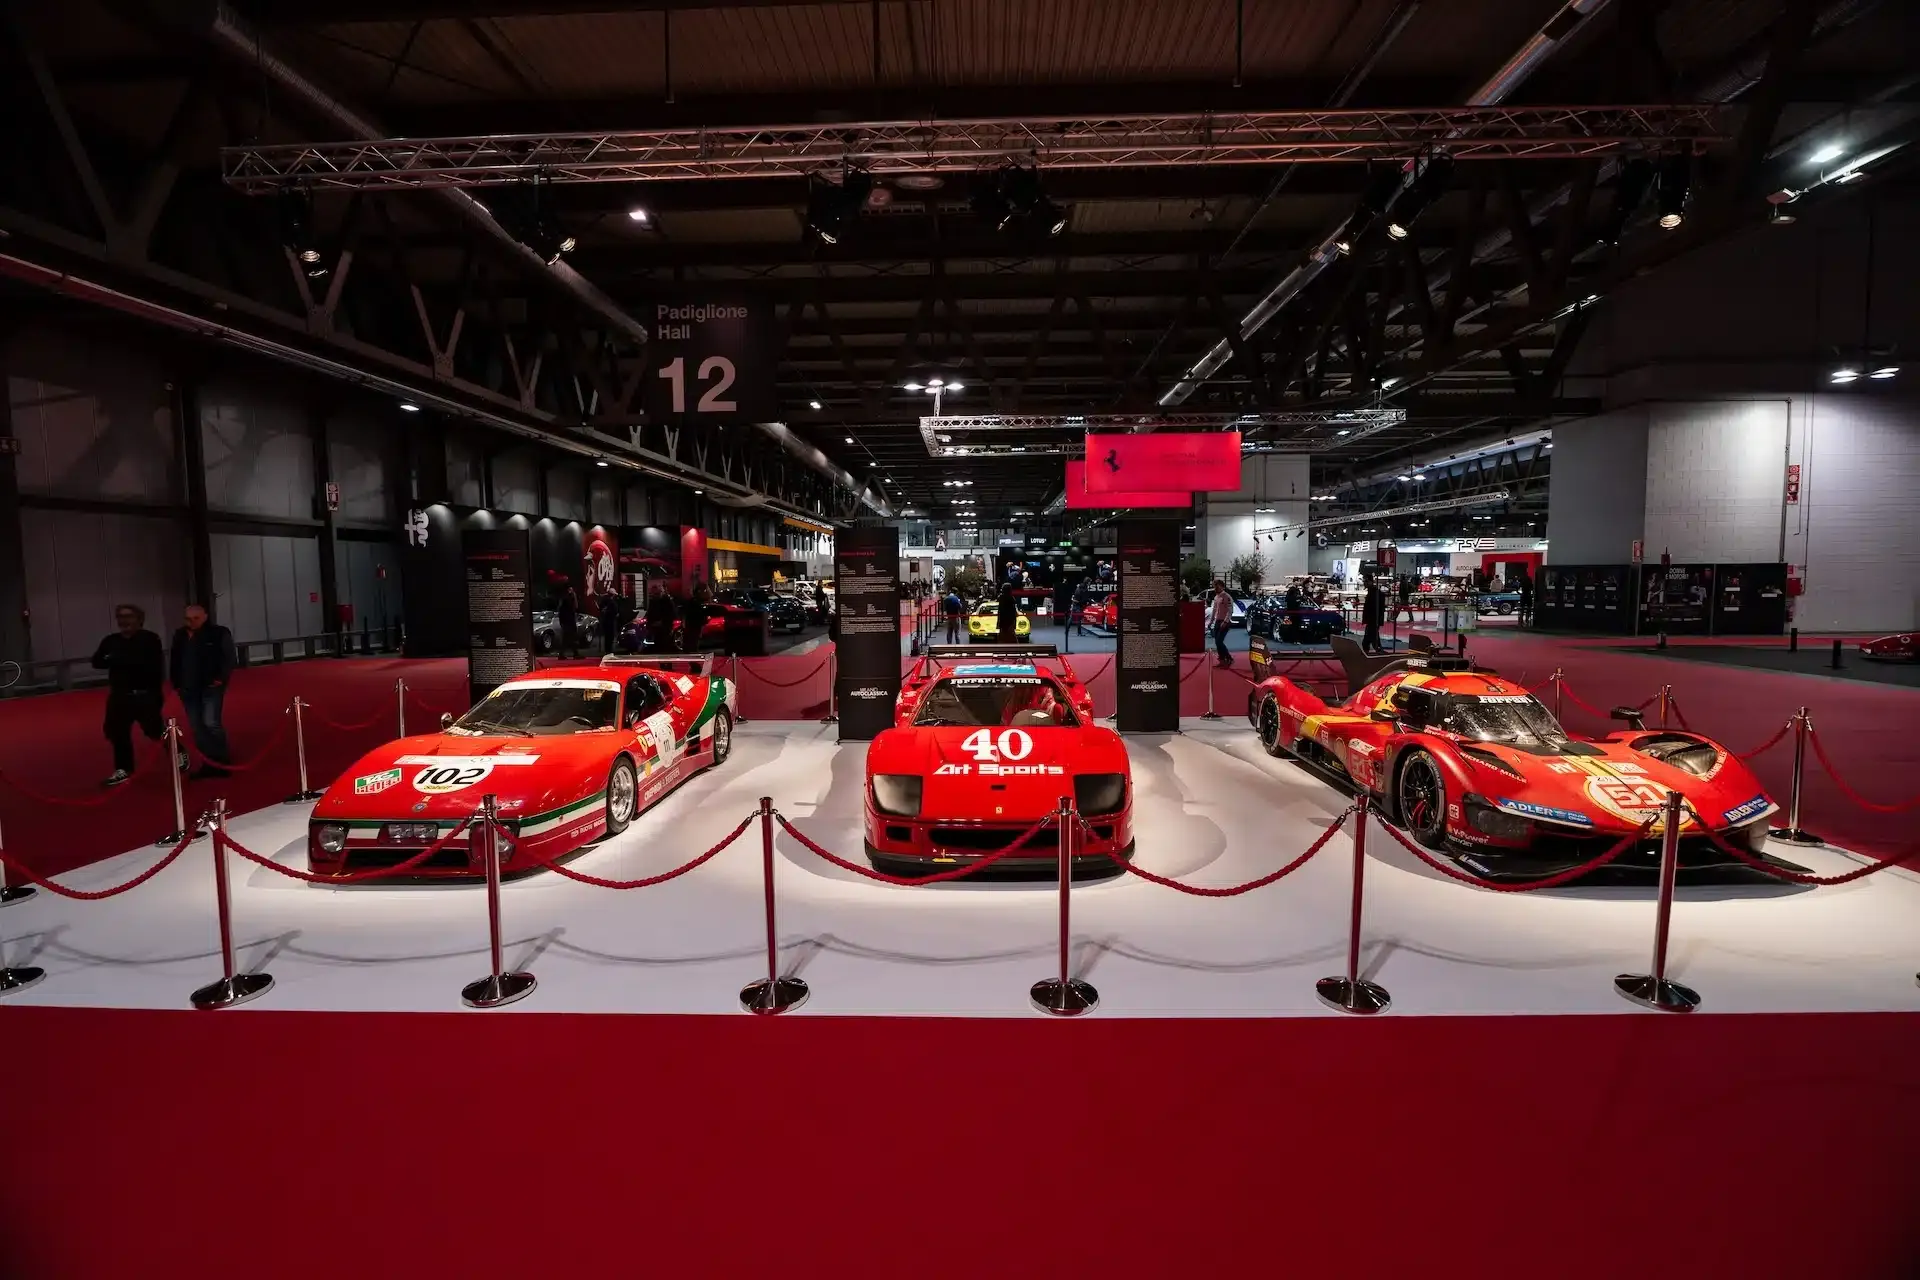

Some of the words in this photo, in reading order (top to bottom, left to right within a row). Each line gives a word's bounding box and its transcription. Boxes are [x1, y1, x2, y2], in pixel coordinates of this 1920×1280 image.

[657, 303, 748, 323] Padiglione
[658, 324, 691, 340] Hall
[658, 355, 737, 413] 12
[936, 537, 947, 549] A
[1317, 535, 1328, 547] C
[960, 728, 1034, 761] 40
[416, 768, 485, 785] 102
[932, 763, 973, 775] Art
[978, 763, 1064, 777] Sports
[1602, 785, 1667, 806] 51
[1505, 801, 1544, 816] ADLER
[1725, 804, 1755, 822] ADLER
